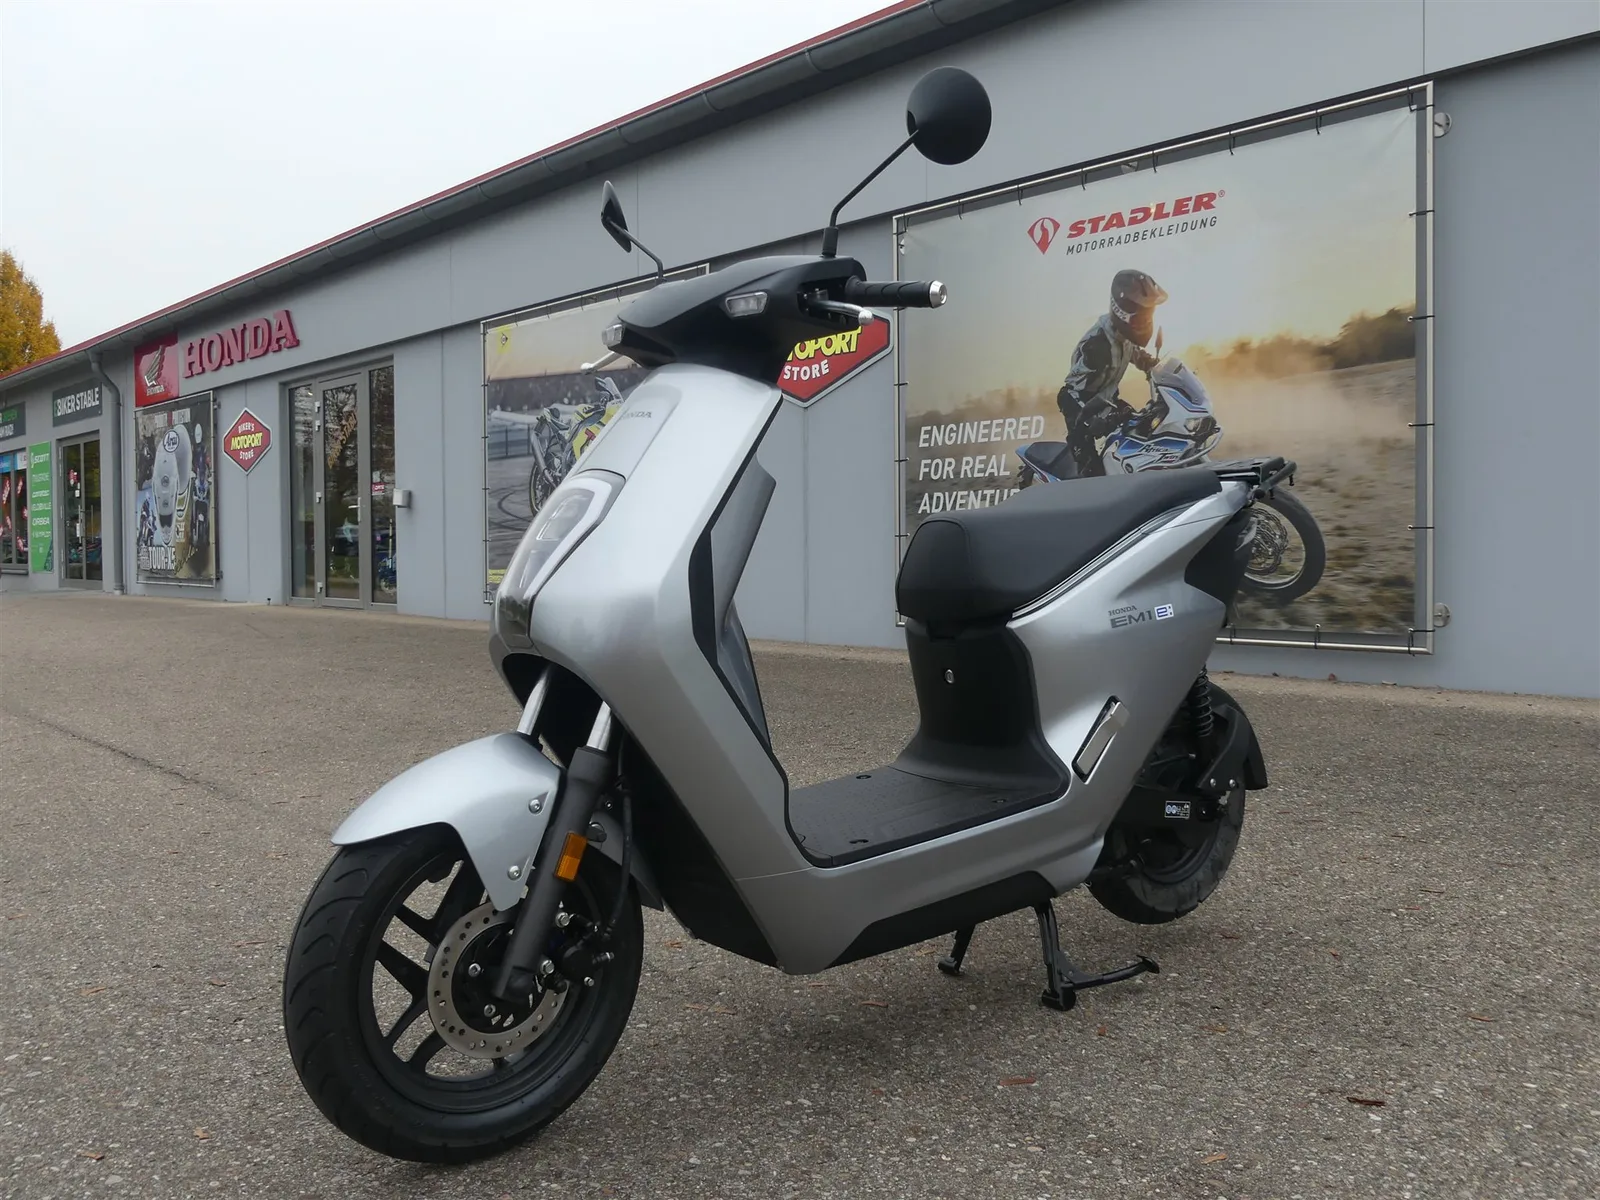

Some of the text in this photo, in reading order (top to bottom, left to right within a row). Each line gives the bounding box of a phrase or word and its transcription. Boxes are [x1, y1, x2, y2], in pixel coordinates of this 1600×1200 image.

[1067, 192, 1217, 239] STADLER
[1066, 216, 1217, 256] MOTORRADBEKLEIDUNG
[182, 309, 300, 379] HONDA
[787, 326, 862, 361] OPORT
[783, 359, 829, 381] STORE
[76, 387, 100, 411] STABLE
[230, 432, 263, 451] MOTOPORT
[919, 415, 1045, 448] ENGINEERED
[239, 449, 254, 460] STORE
[1139, 443, 1169, 454] Africa
[919, 453, 1011, 481] FOR REAL
[918, 488, 1021, 514] ADVENTU
[148, 546, 176, 570] TOUR-X5
[1107, 604, 1138, 617] HONDA
[1109, 610, 1153, 629] EM1
